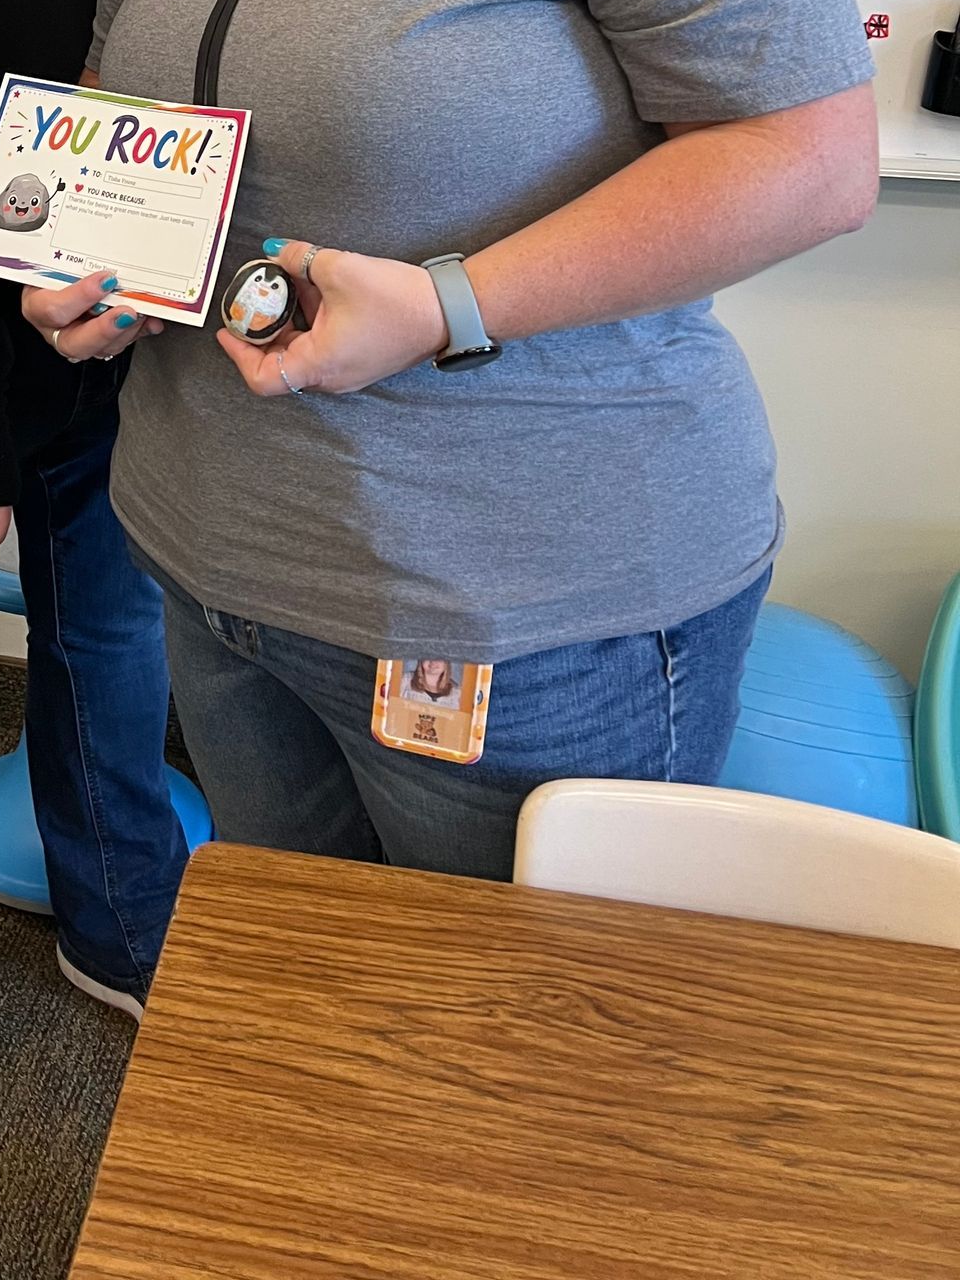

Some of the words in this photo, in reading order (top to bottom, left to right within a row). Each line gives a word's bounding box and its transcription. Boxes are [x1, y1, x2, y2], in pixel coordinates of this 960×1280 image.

[32, 105, 101, 155] YOU
[104, 114, 213, 176] ROCK!
[87, 187, 100, 196] YOU
[100, 190, 118, 200] ROCK
